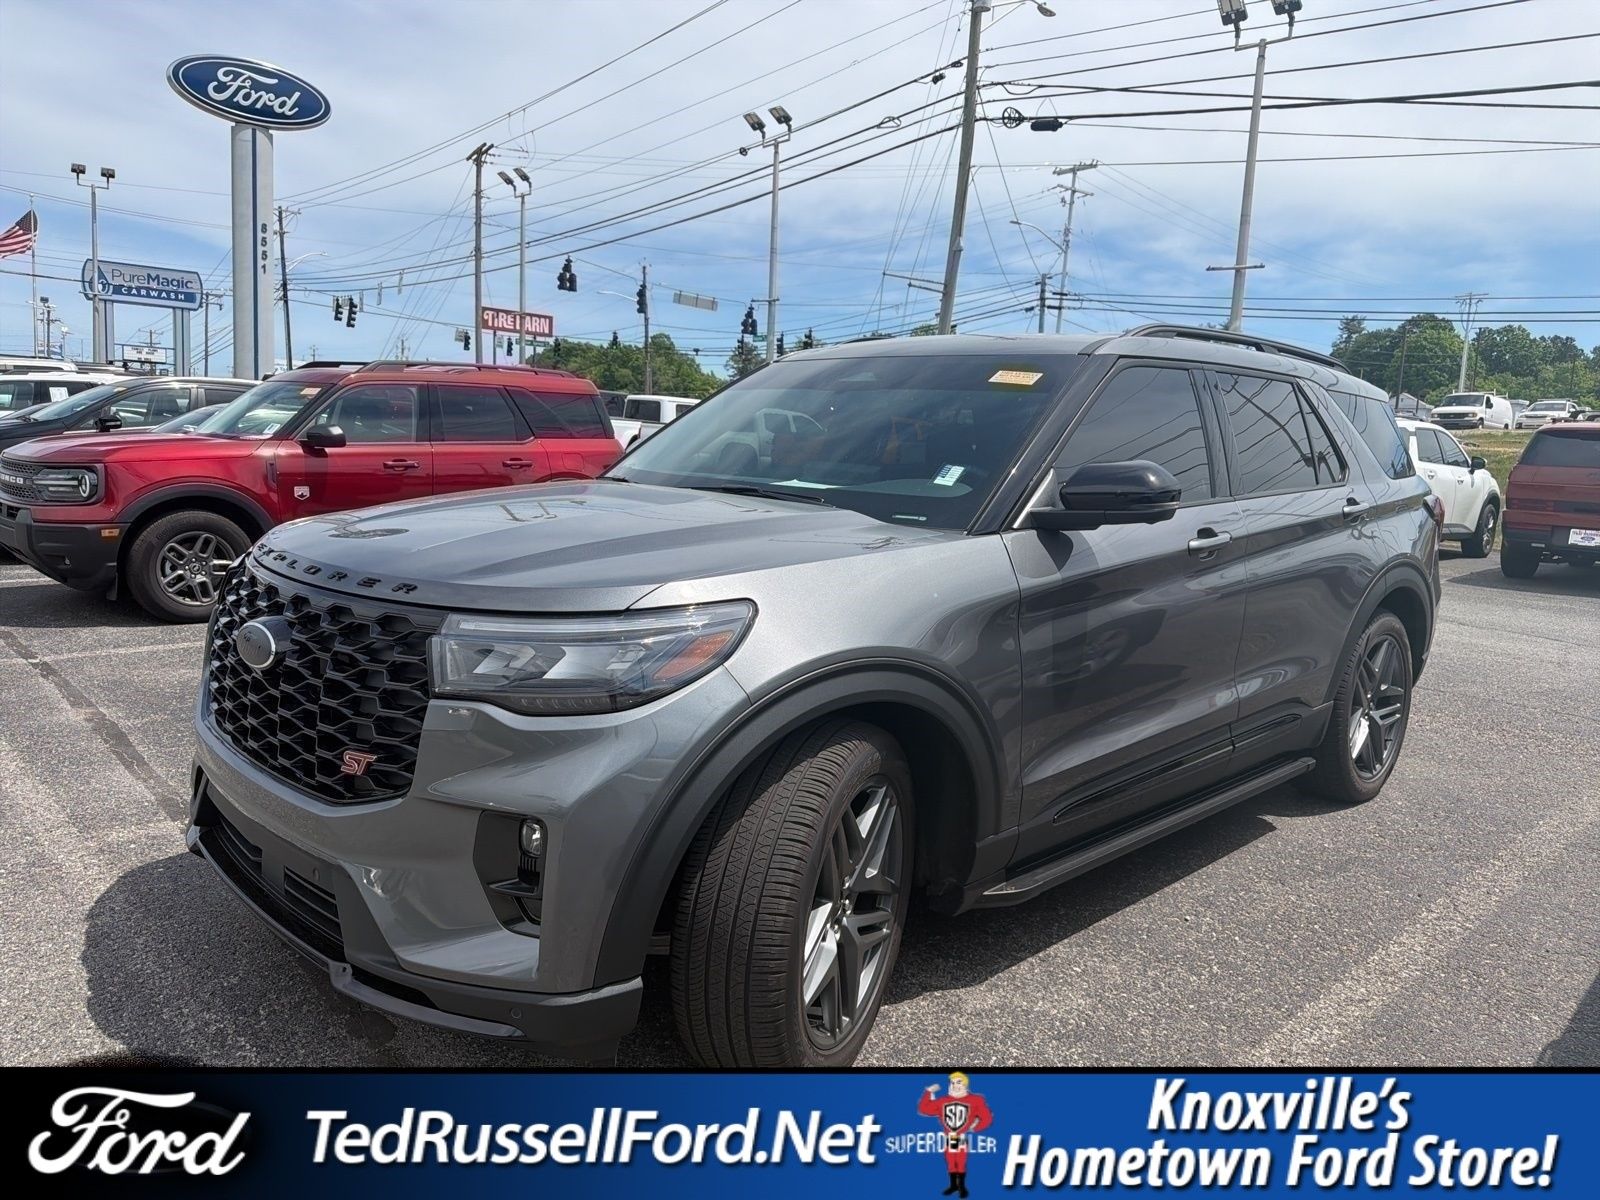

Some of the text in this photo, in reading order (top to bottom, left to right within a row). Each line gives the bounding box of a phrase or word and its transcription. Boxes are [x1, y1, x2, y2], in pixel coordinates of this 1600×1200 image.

[207, 66, 301, 116] Ford
[111, 268, 194, 290] PureMagic
[121, 287, 185, 300] CARWASH
[257, 542, 418, 594] EXPLORER
[340, 750, 378, 775] ST
